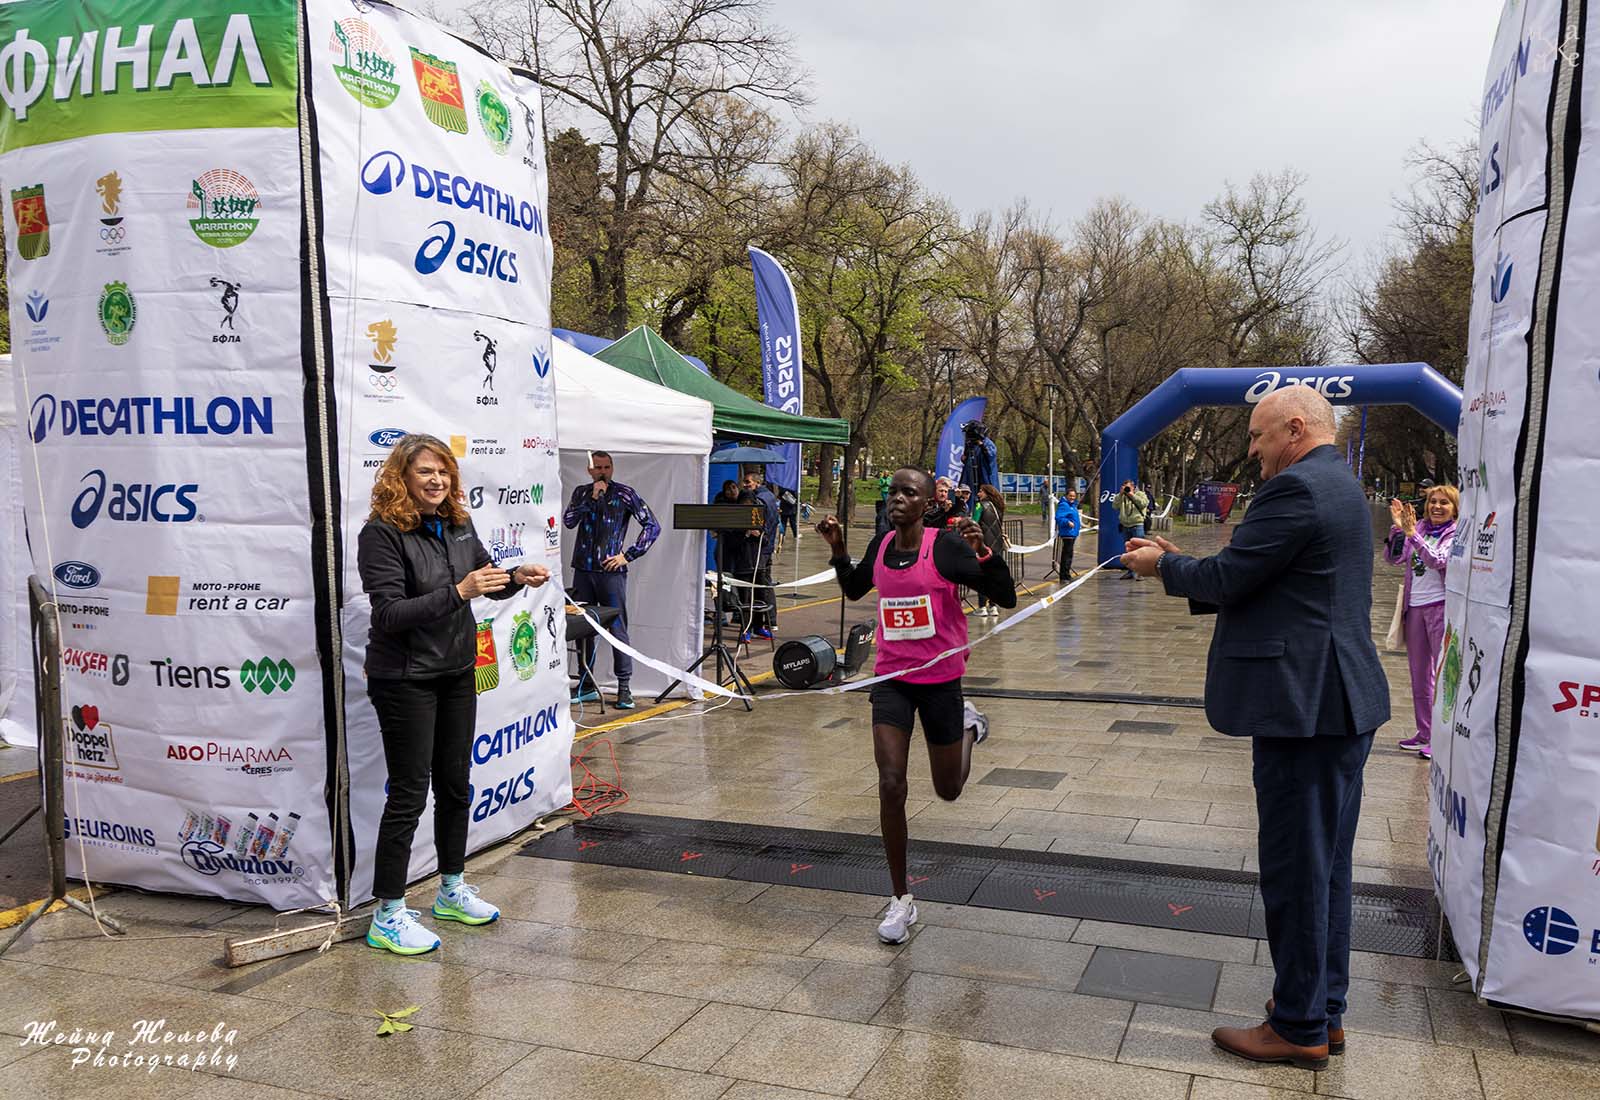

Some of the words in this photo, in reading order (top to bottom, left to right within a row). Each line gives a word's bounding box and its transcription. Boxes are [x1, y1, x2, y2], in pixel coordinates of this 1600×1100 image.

[0, 14, 271, 122] ФИНАЛ
[411, 164, 543, 237] DECATHLON
[195, 222, 253, 231] MARATHON
[212, 335, 241, 344] БФЛА
[476, 396, 498, 406] БФЛА
[61, 397, 273, 435] DECATHLON
[471, 446, 488, 455] rent
[498, 485, 530, 505] Tiens
[64, 565, 92, 584] Ford
[192, 583, 261, 591] MOTO-PFOHE
[189, 595, 230, 610] rent
[235, 598, 248, 610] a
[255, 598, 290, 610] car
[893, 610, 915, 627] 53
[63, 647, 108, 674] ONSER
[783, 657, 811, 670] MYLAPS
[150, 657, 231, 689] Tiens
[471, 703, 559, 767] CATHLON
[77, 744, 106, 762] herz
[246, 766, 273, 775] CERES
[74, 818, 156, 847] EUROINS
